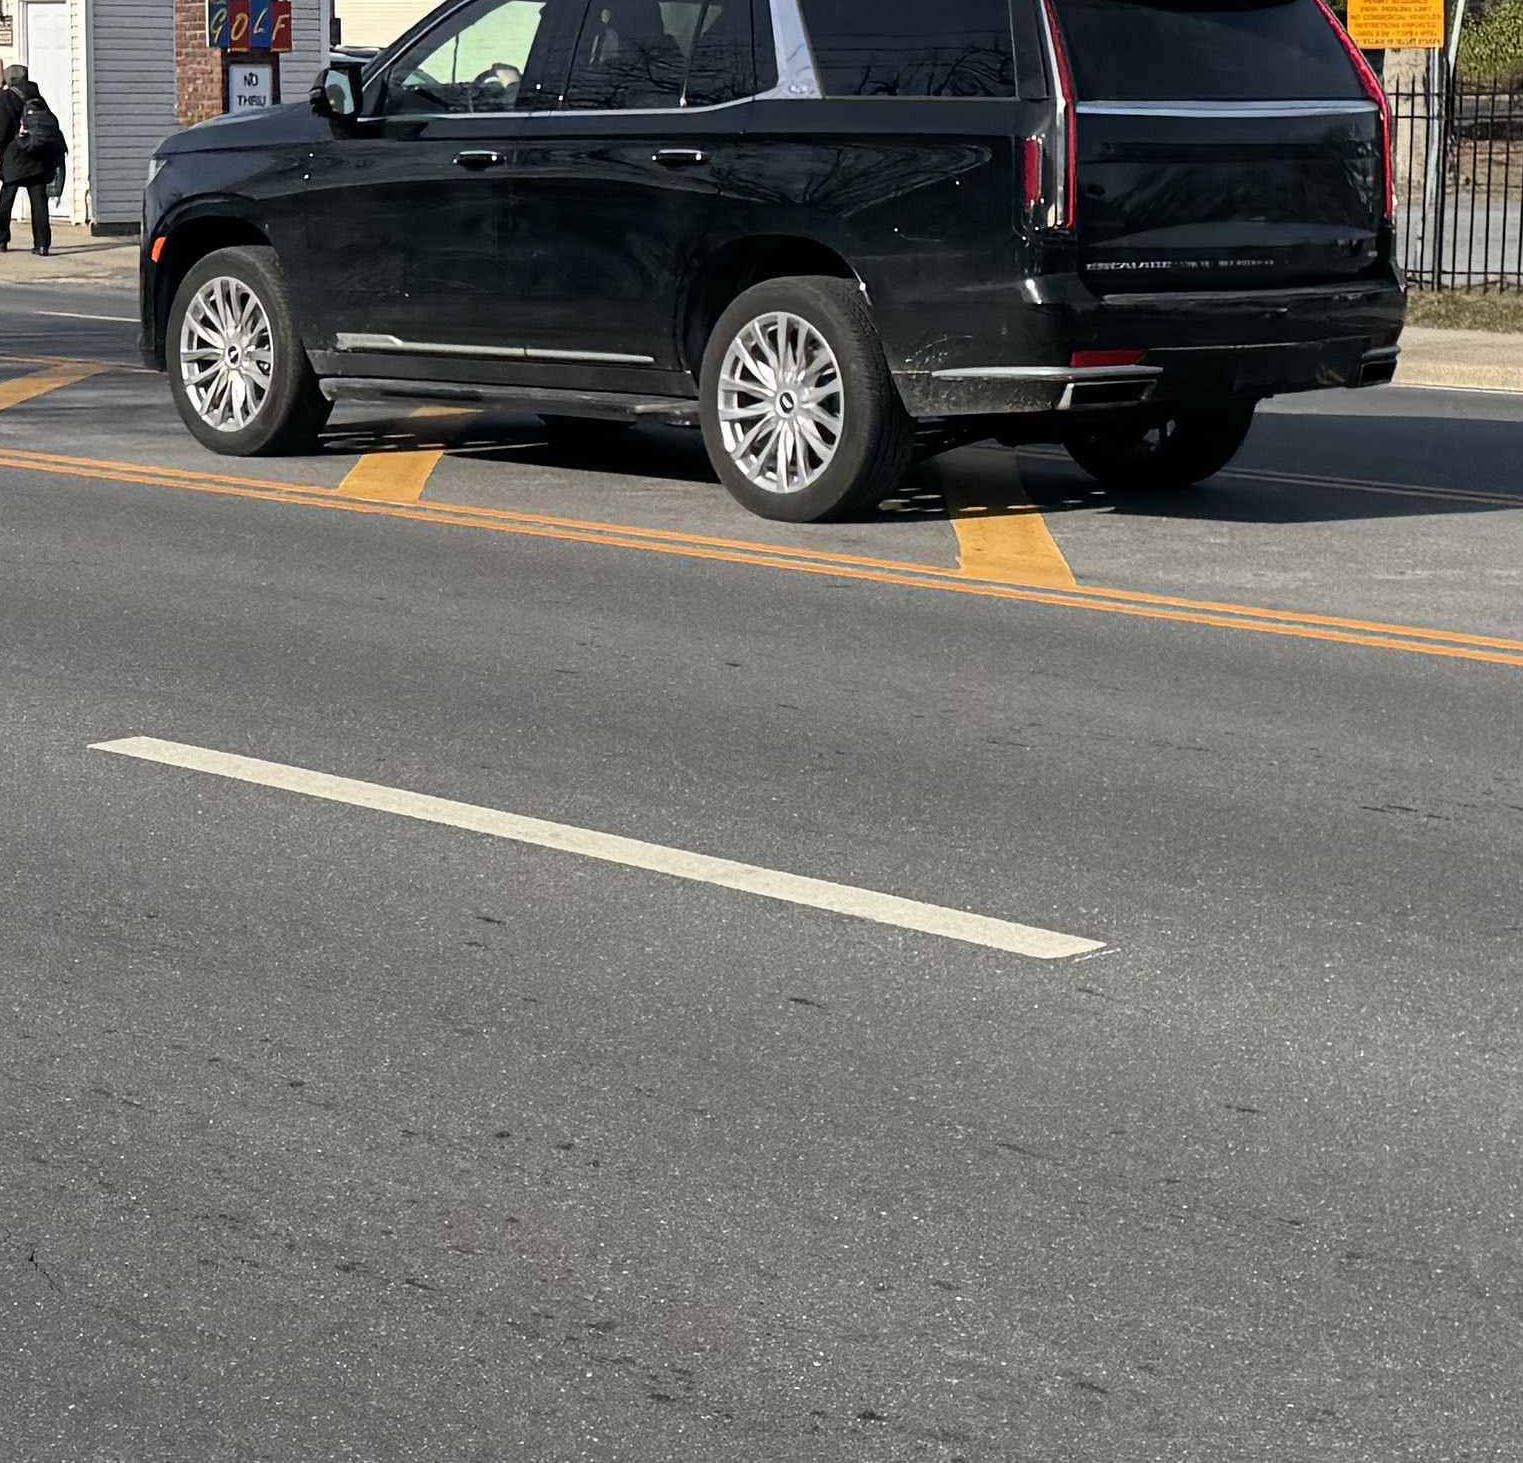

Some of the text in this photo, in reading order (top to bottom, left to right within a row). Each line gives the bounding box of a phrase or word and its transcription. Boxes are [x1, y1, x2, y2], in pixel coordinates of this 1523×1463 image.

[211, 7, 290, 44] GOLF
[244, 72, 258, 86] NO
[237, 95, 266, 107] THRU
